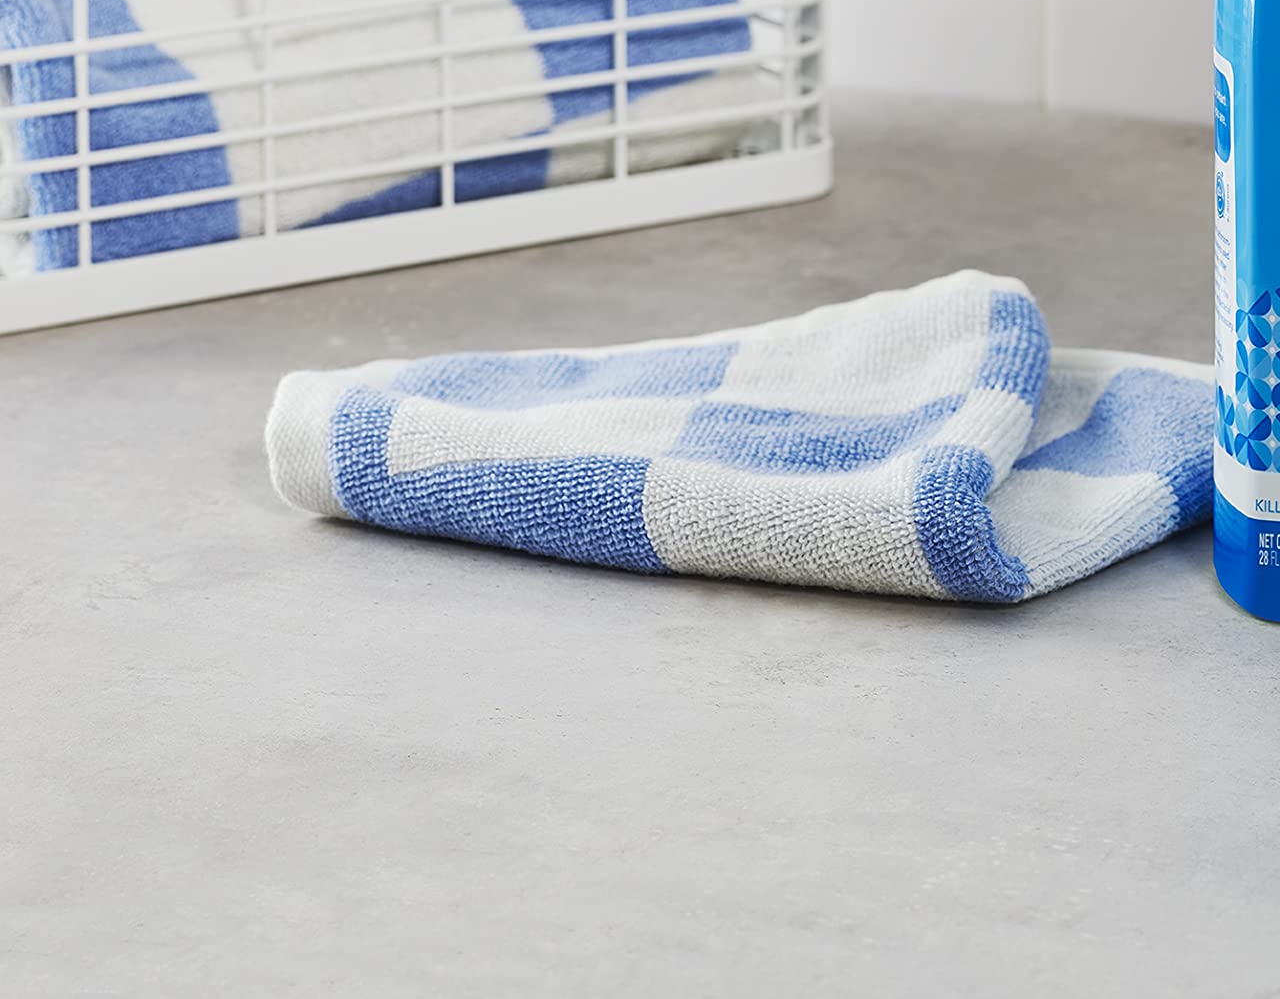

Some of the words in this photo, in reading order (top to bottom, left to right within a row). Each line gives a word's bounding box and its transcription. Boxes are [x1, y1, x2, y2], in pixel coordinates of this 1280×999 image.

[1258, 532, 1275, 549] NET
[1258, 549, 1269, 566] 28
[1270, 550, 1280, 567] FL
